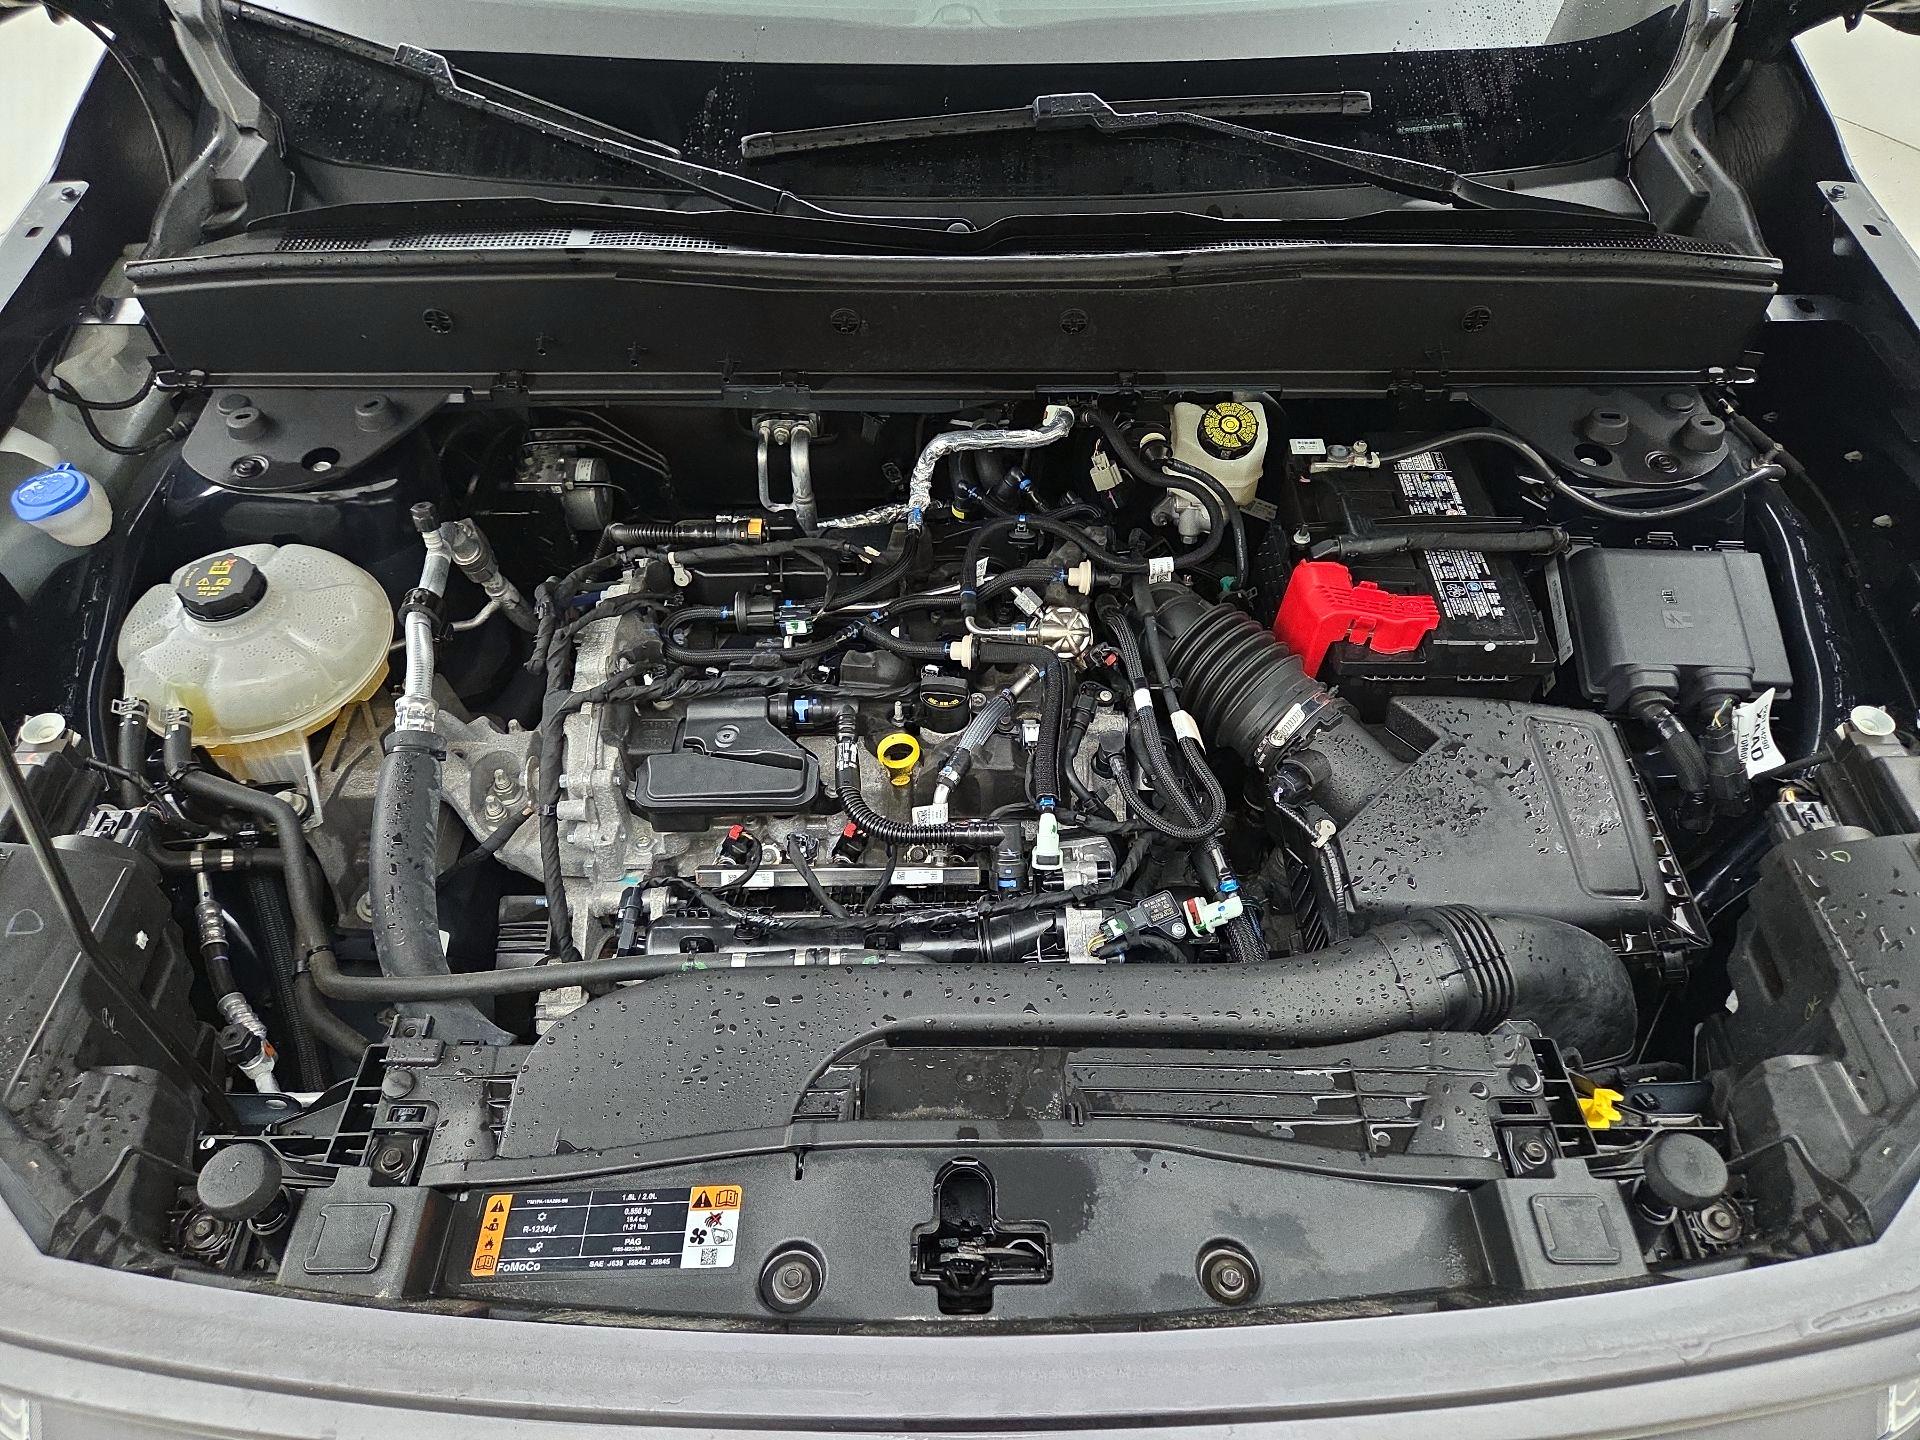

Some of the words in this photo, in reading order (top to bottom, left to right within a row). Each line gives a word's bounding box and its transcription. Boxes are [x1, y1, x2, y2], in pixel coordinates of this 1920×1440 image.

[643, 1207, 652, 1216] kg
[522, 1225, 557, 1234] R-1234yf
[497, 1261, 540, 1272] FoMoCo
